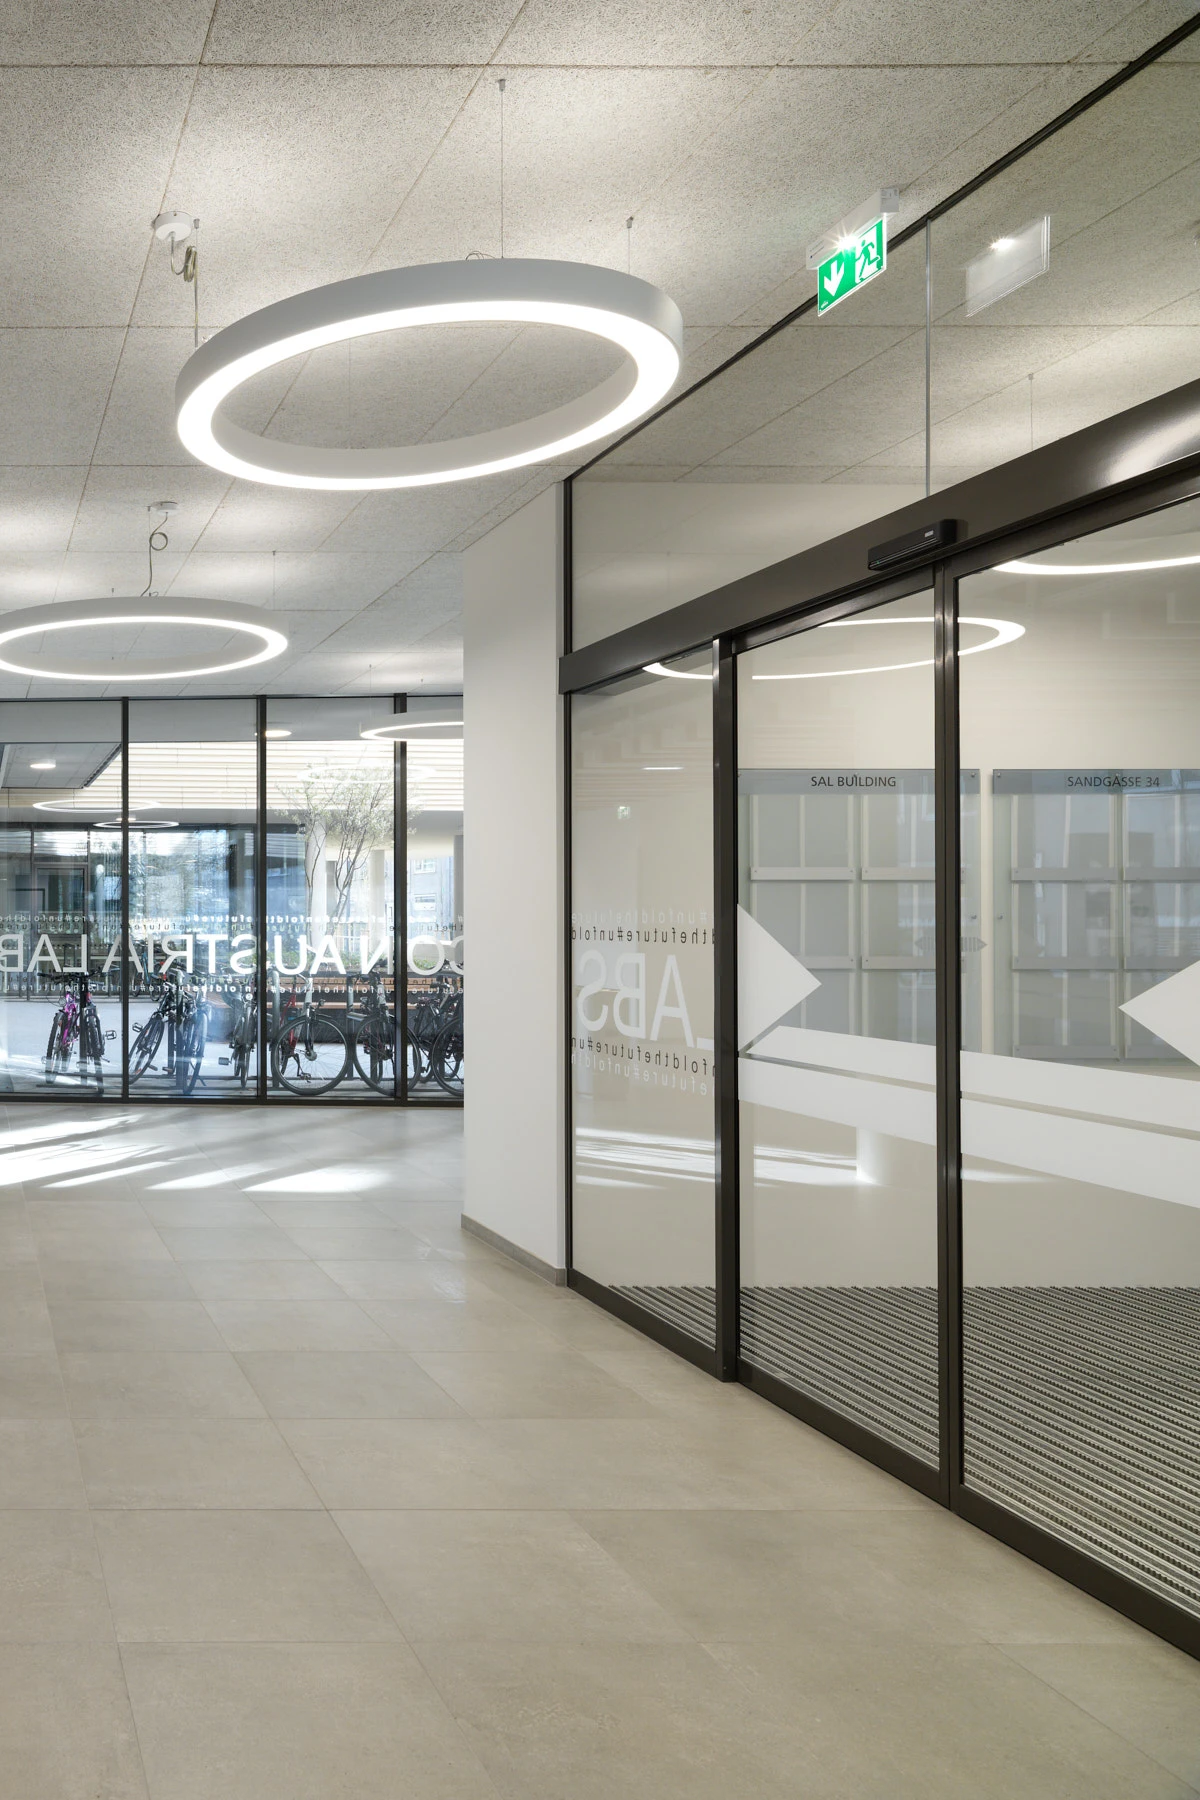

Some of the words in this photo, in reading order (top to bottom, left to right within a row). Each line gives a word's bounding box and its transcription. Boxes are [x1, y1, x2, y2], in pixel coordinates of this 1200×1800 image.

[811, 776, 834, 787] SAL
[837, 775, 896, 787] BUILDING
[1067, 776, 1142, 787] SANDGASSE
[1145, 776, 1161, 787] 34
